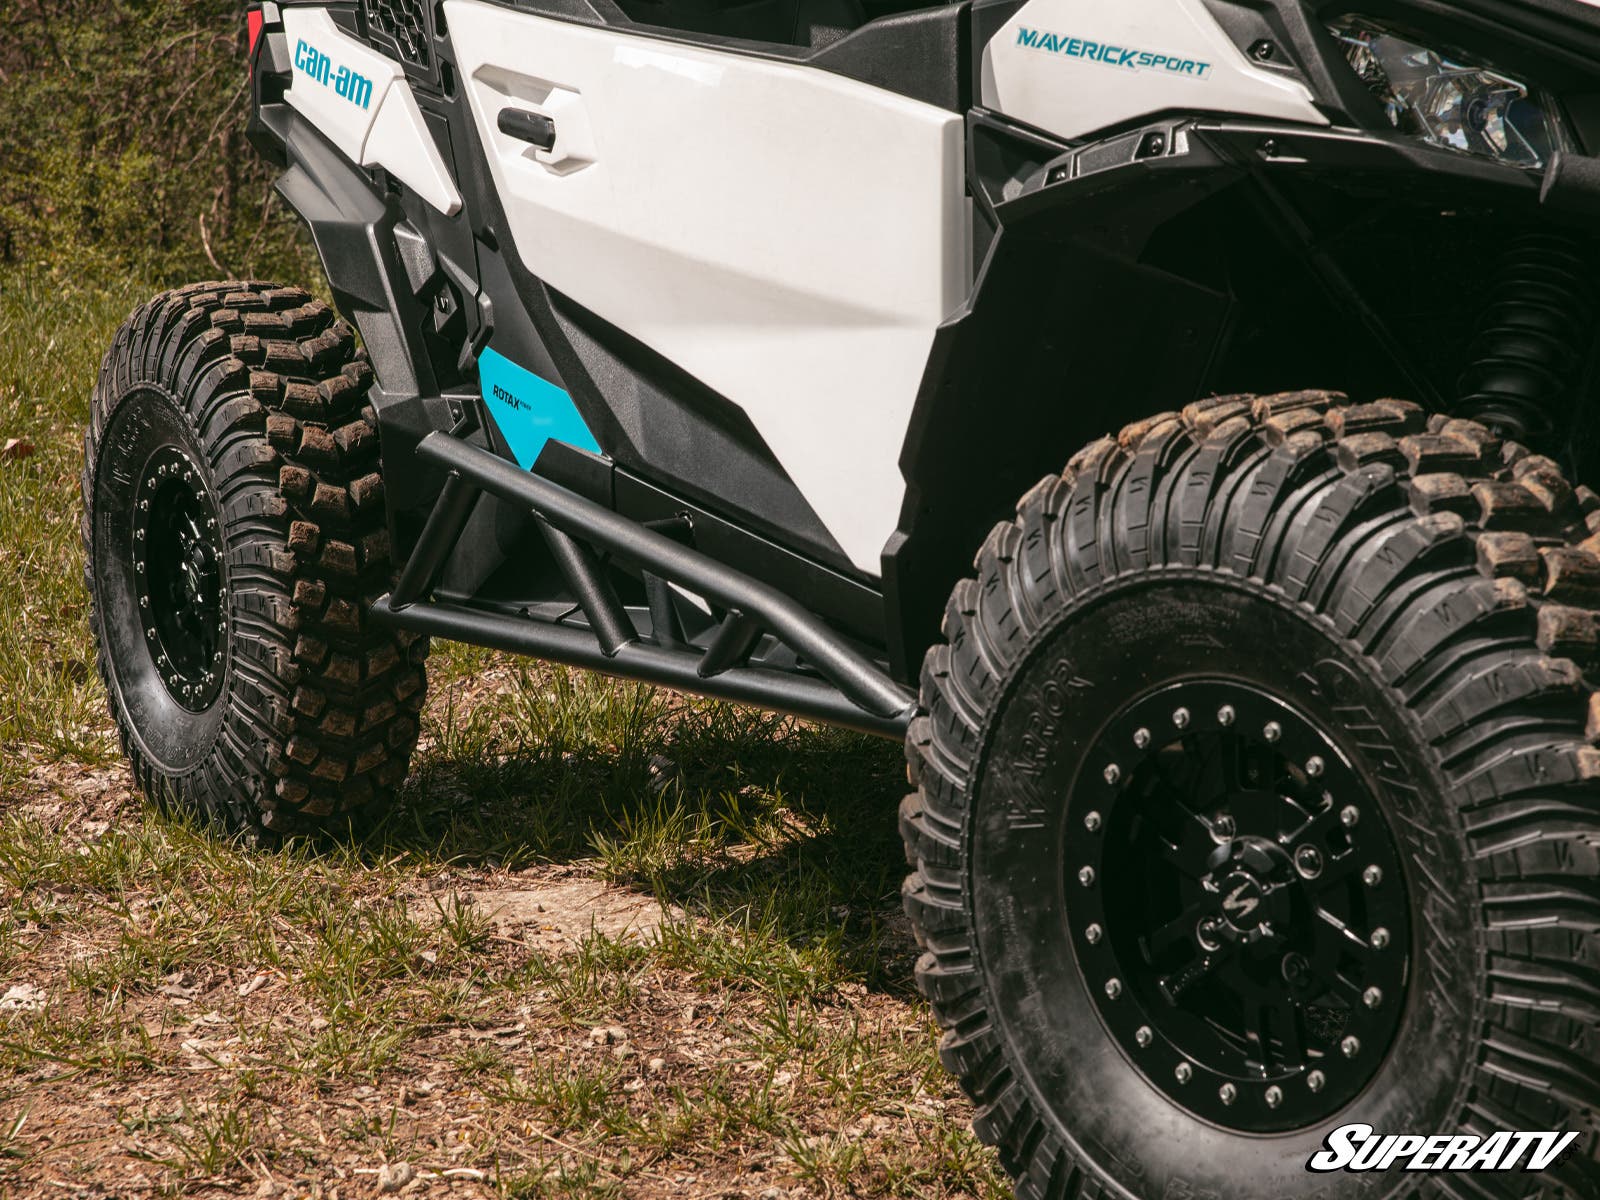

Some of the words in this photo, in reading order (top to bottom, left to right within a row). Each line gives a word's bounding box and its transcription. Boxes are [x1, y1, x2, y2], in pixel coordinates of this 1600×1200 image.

[294, 38, 373, 110] can-am
[1016, 27, 1140, 68] MAVERICK
[1136, 52, 1211, 76] SPORT
[492, 384, 520, 411] ROTAX
[1004, 657, 1097, 830] WARRIOR
